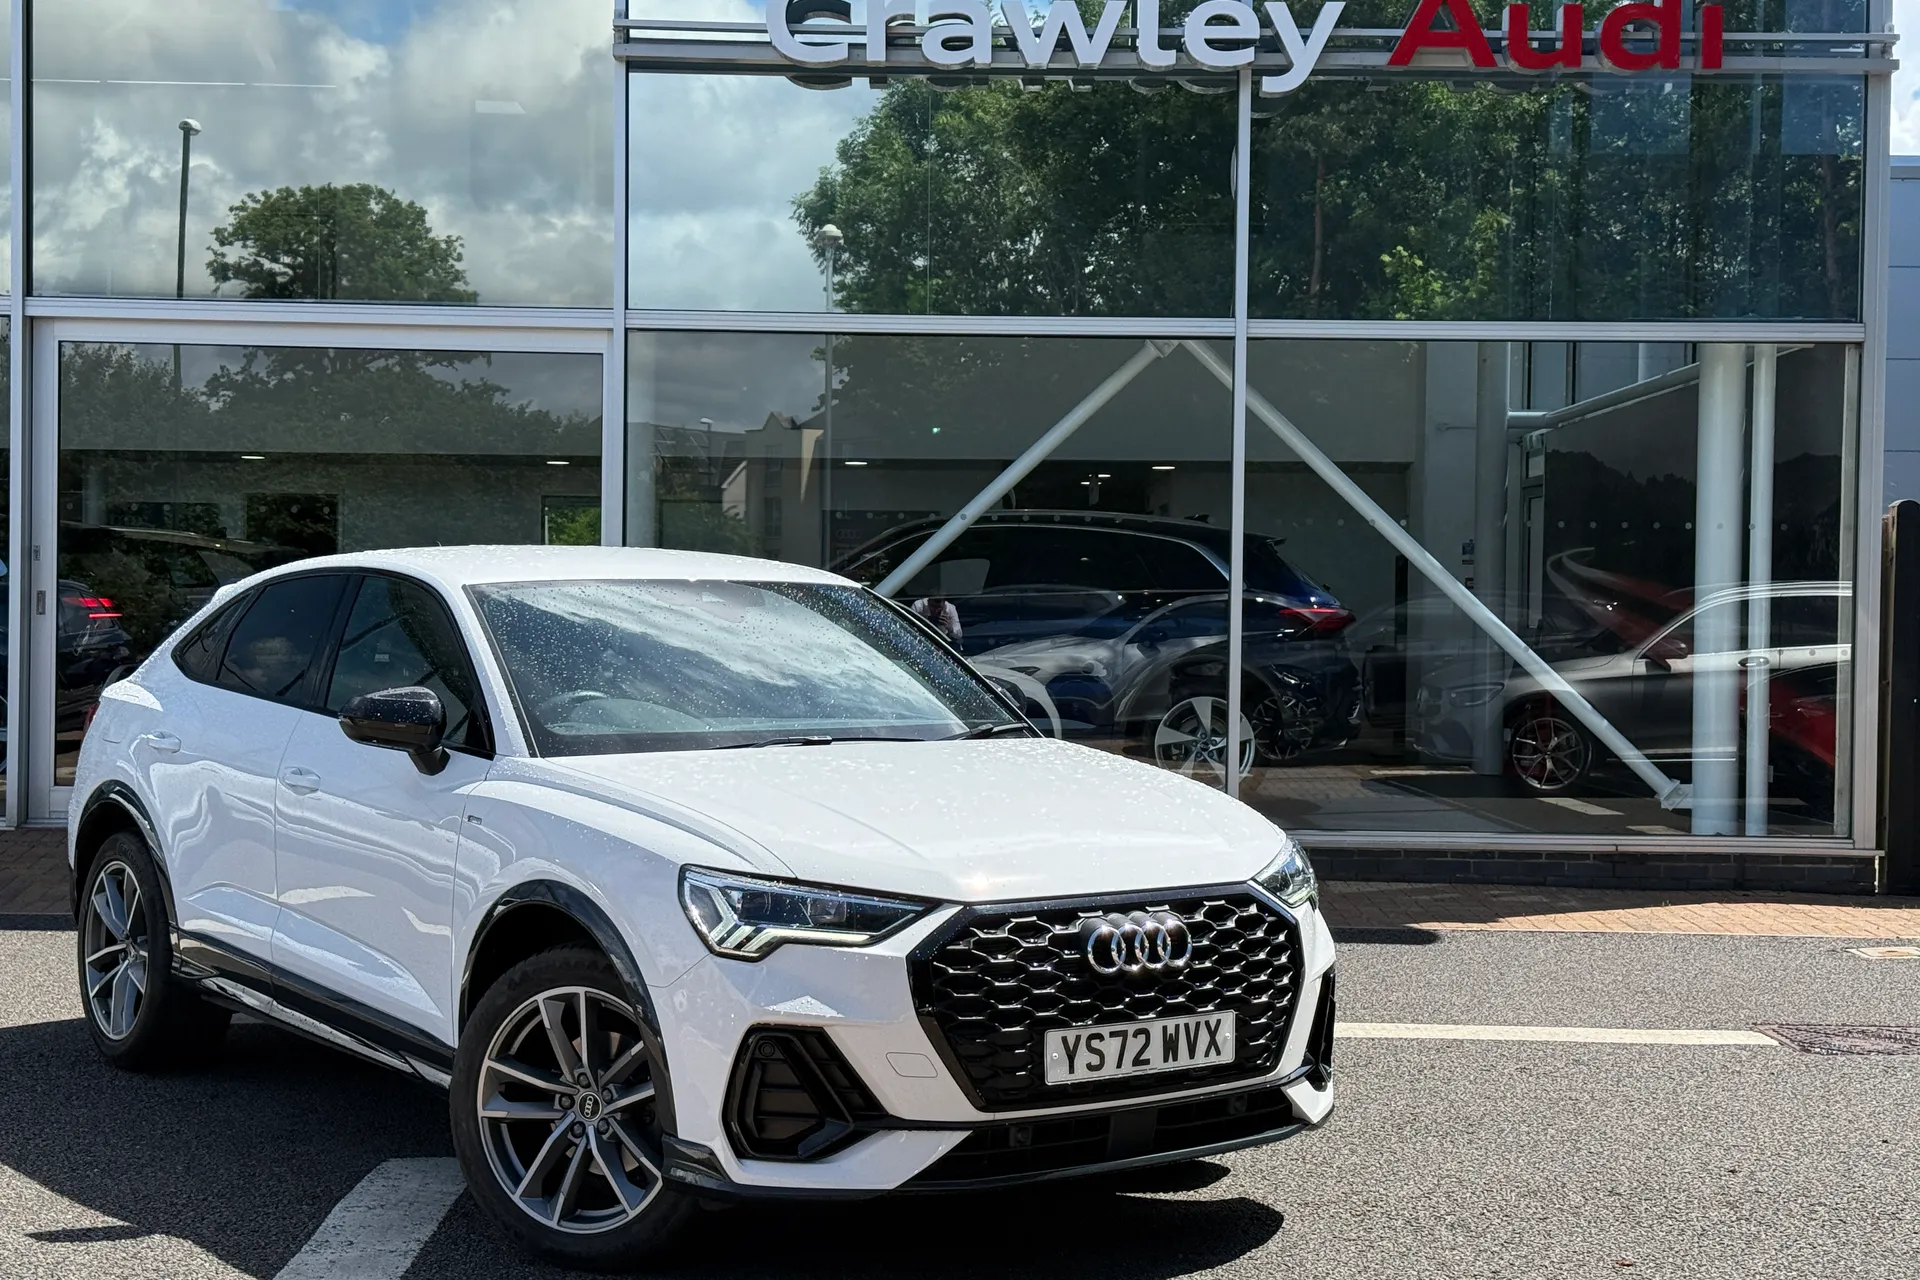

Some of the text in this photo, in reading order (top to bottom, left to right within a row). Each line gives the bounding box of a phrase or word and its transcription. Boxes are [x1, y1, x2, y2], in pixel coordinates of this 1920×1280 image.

[766, 0, 1723, 94] Crawley Audi
[1061, 1018, 1222, 1075] YS72 WVX
